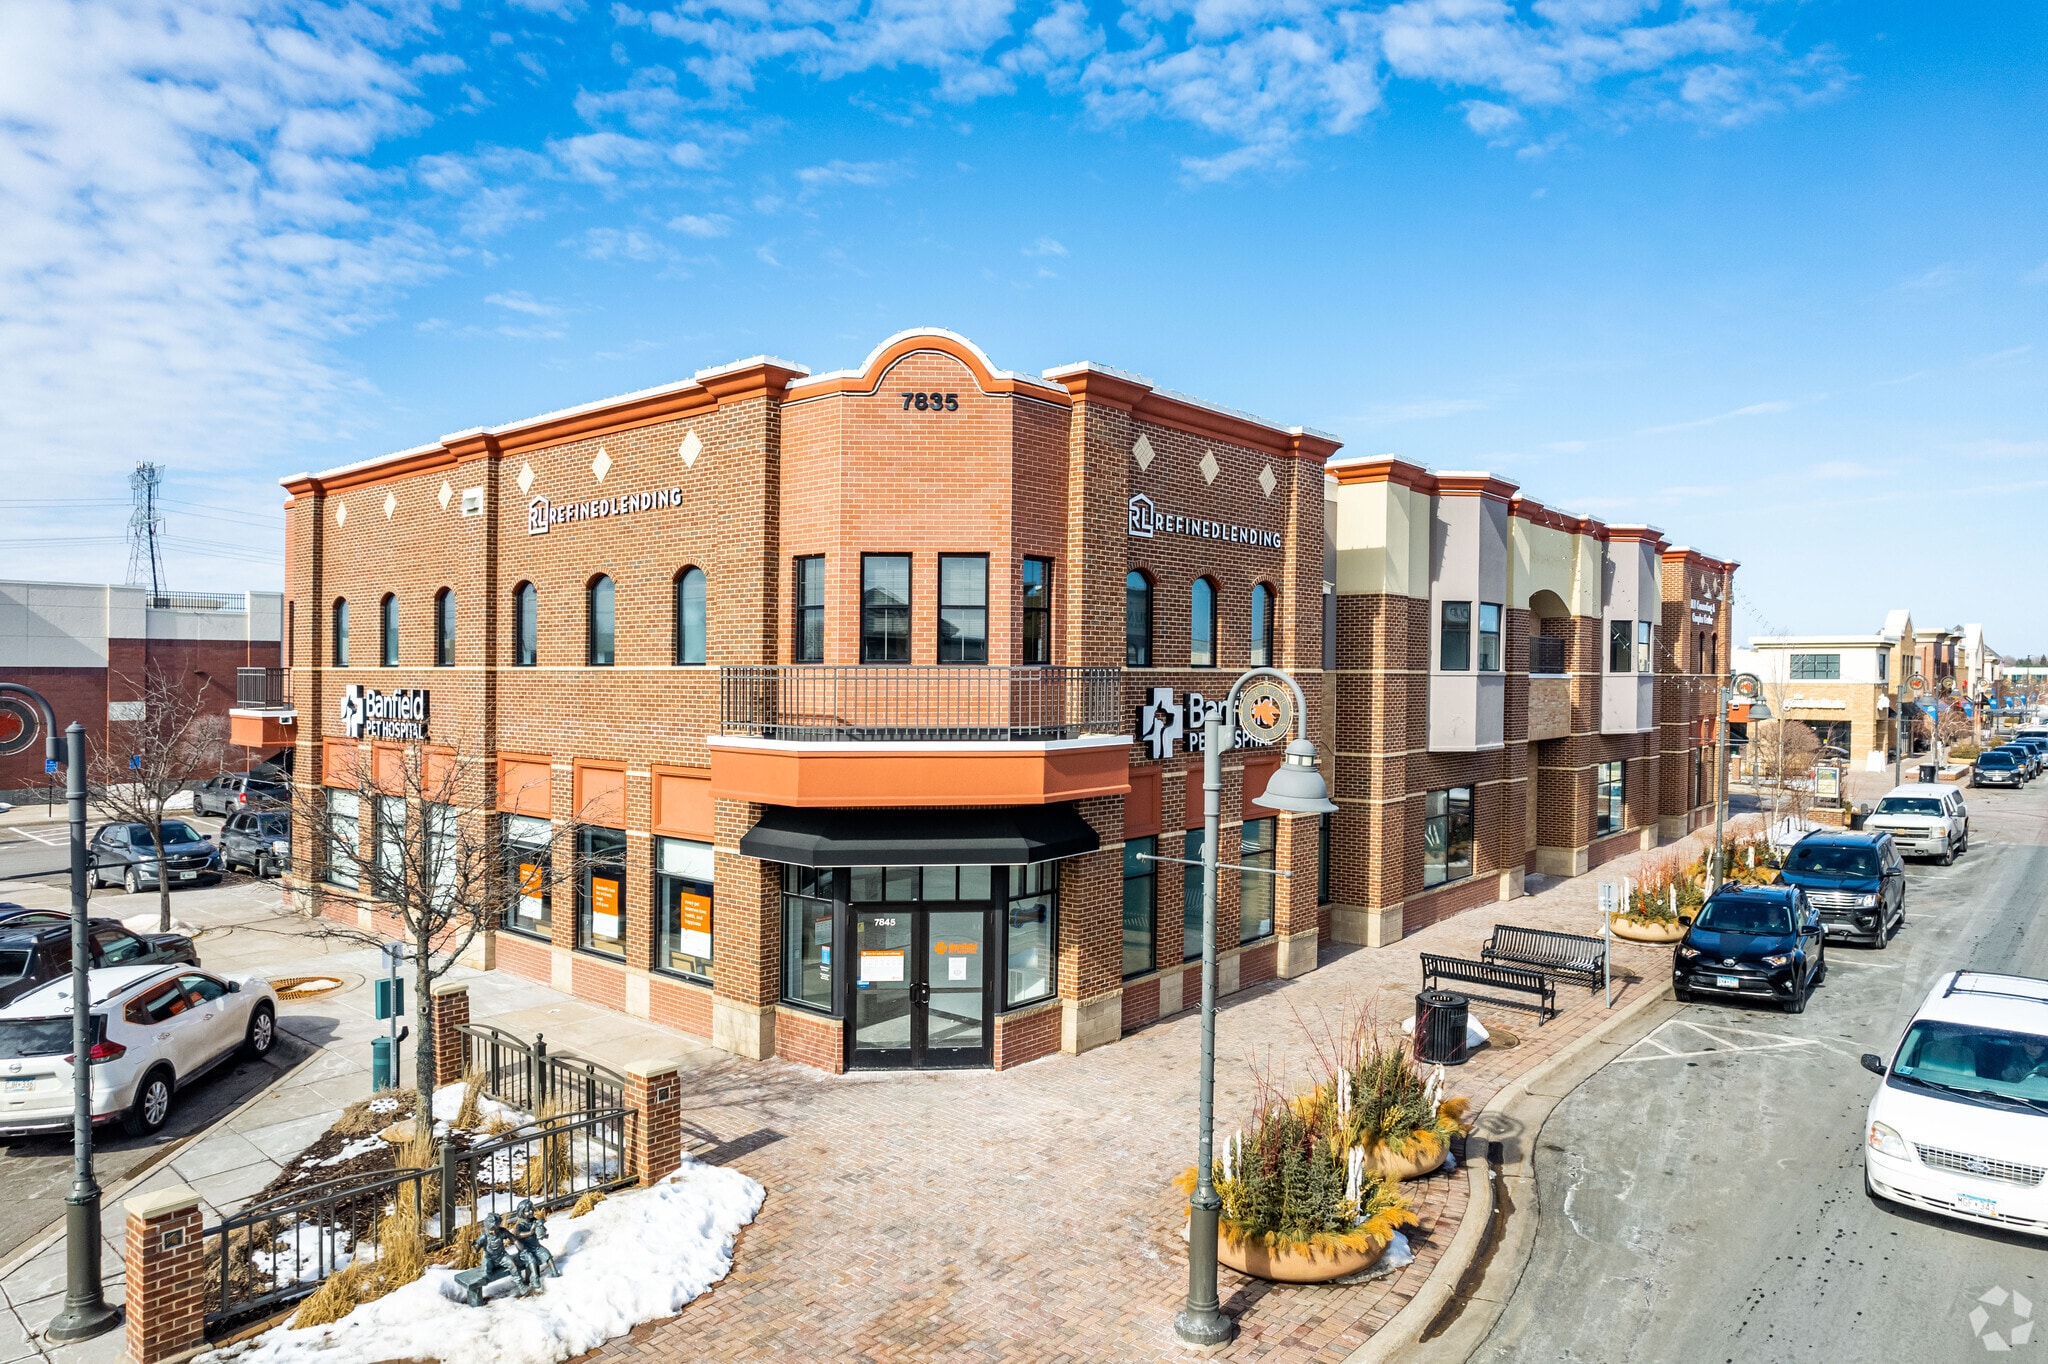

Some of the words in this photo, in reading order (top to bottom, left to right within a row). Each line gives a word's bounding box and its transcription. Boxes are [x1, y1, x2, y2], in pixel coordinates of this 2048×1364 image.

[901, 392, 959, 412] 7835
[1155, 513, 1281, 548] REFINEDLENDING
[366, 689, 424, 720] Banfield
[366, 720, 381, 736] PET
[382, 721, 424, 739] HOSPITAL
[874, 918, 896, 926] 7845
